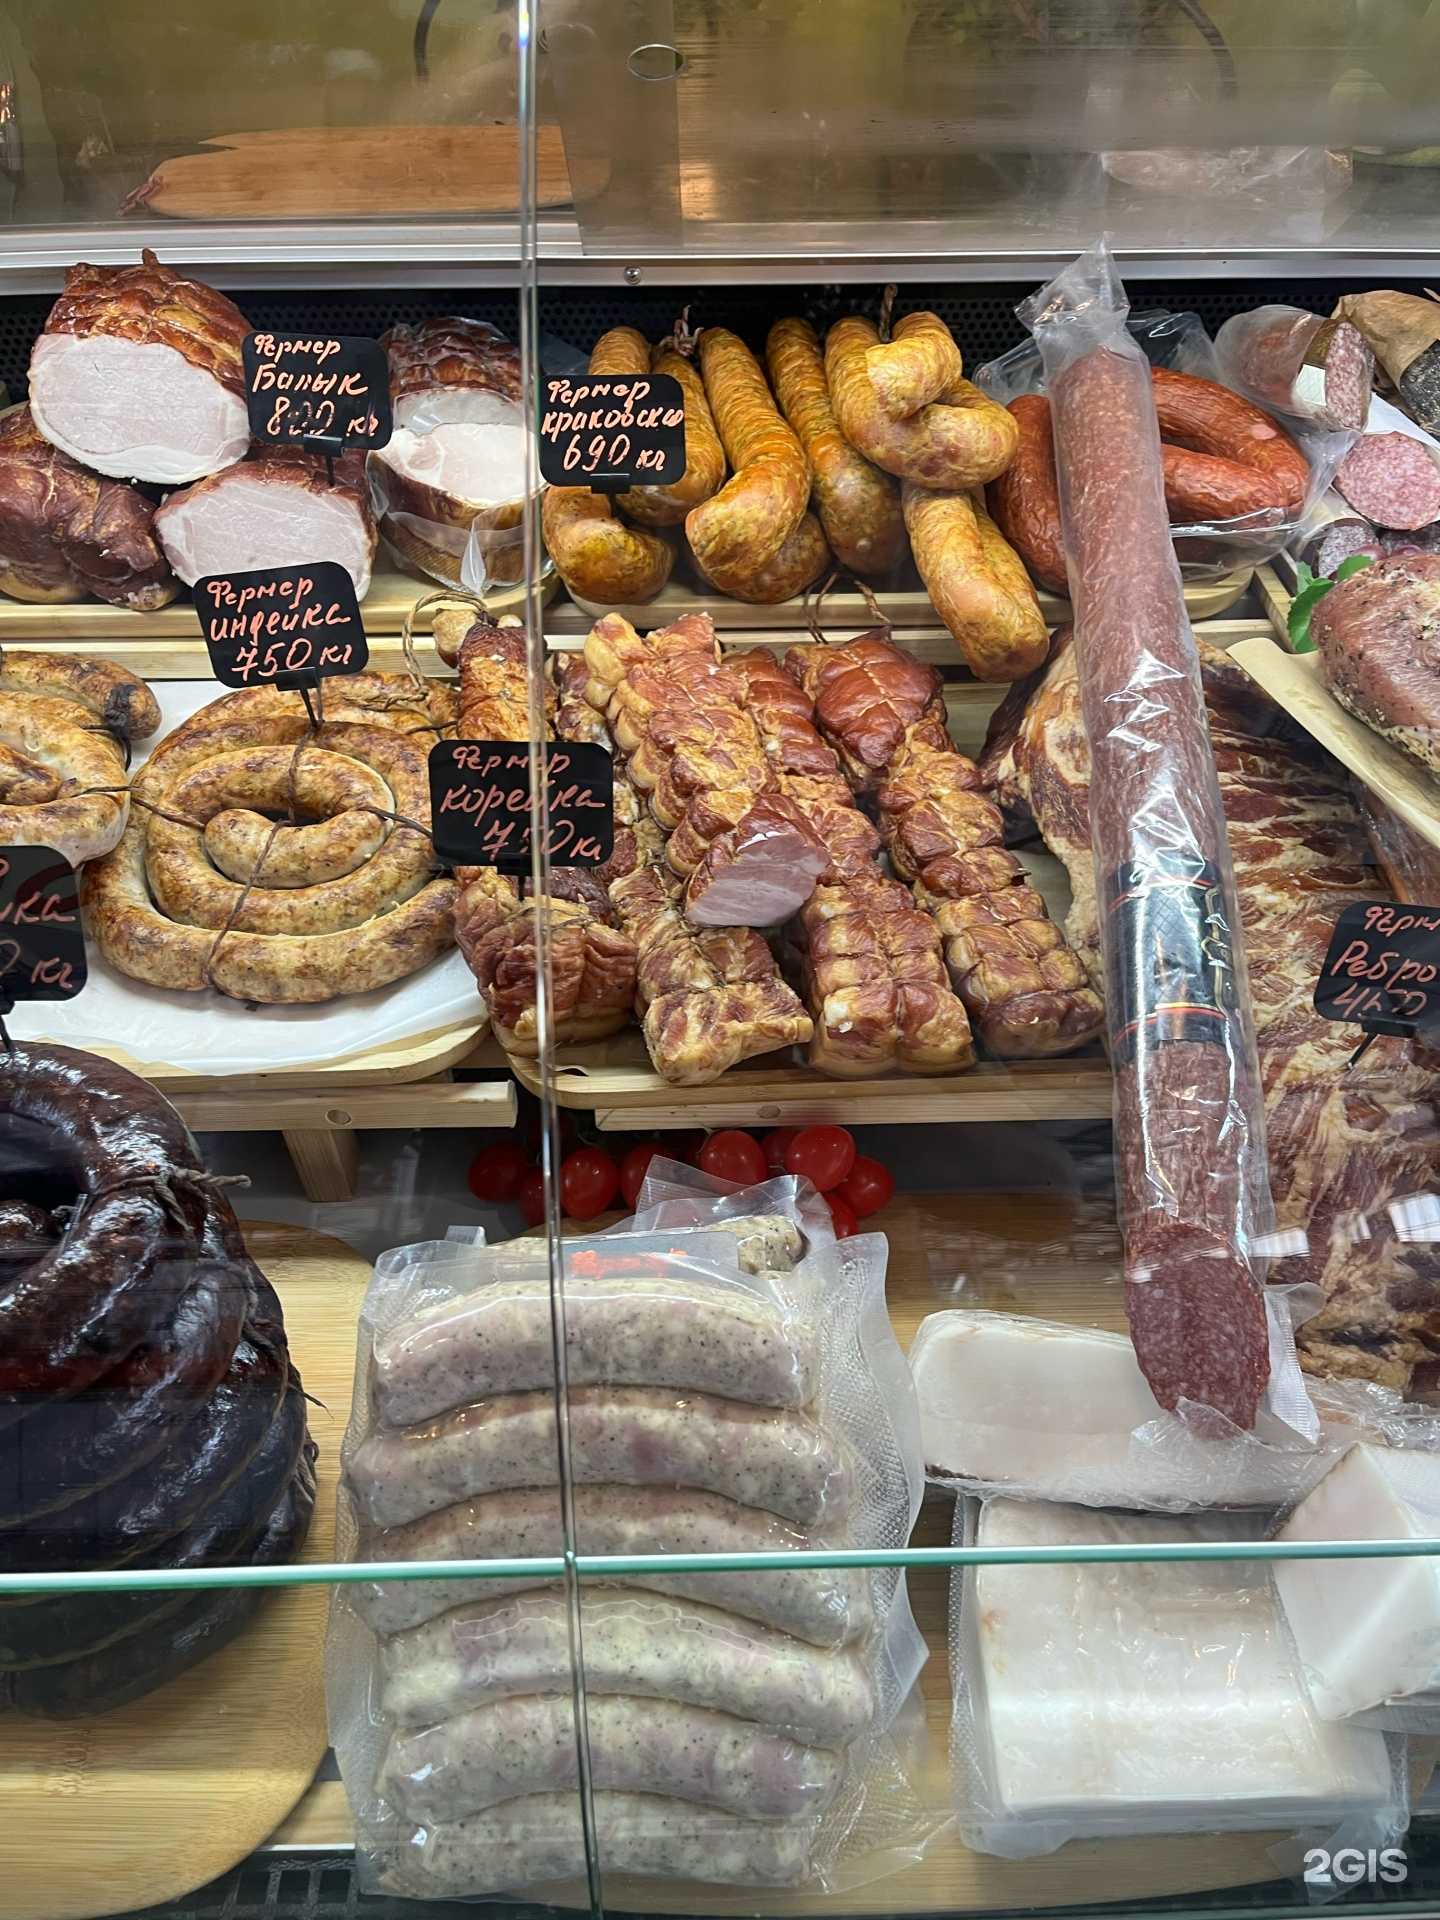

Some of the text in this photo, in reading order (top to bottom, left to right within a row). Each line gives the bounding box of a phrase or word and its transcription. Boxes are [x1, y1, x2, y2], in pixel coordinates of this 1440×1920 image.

[252, 363, 369, 396] Балык
[563, 433, 667, 472] 690 кг
[231, 637, 353, 682] 750 кг
